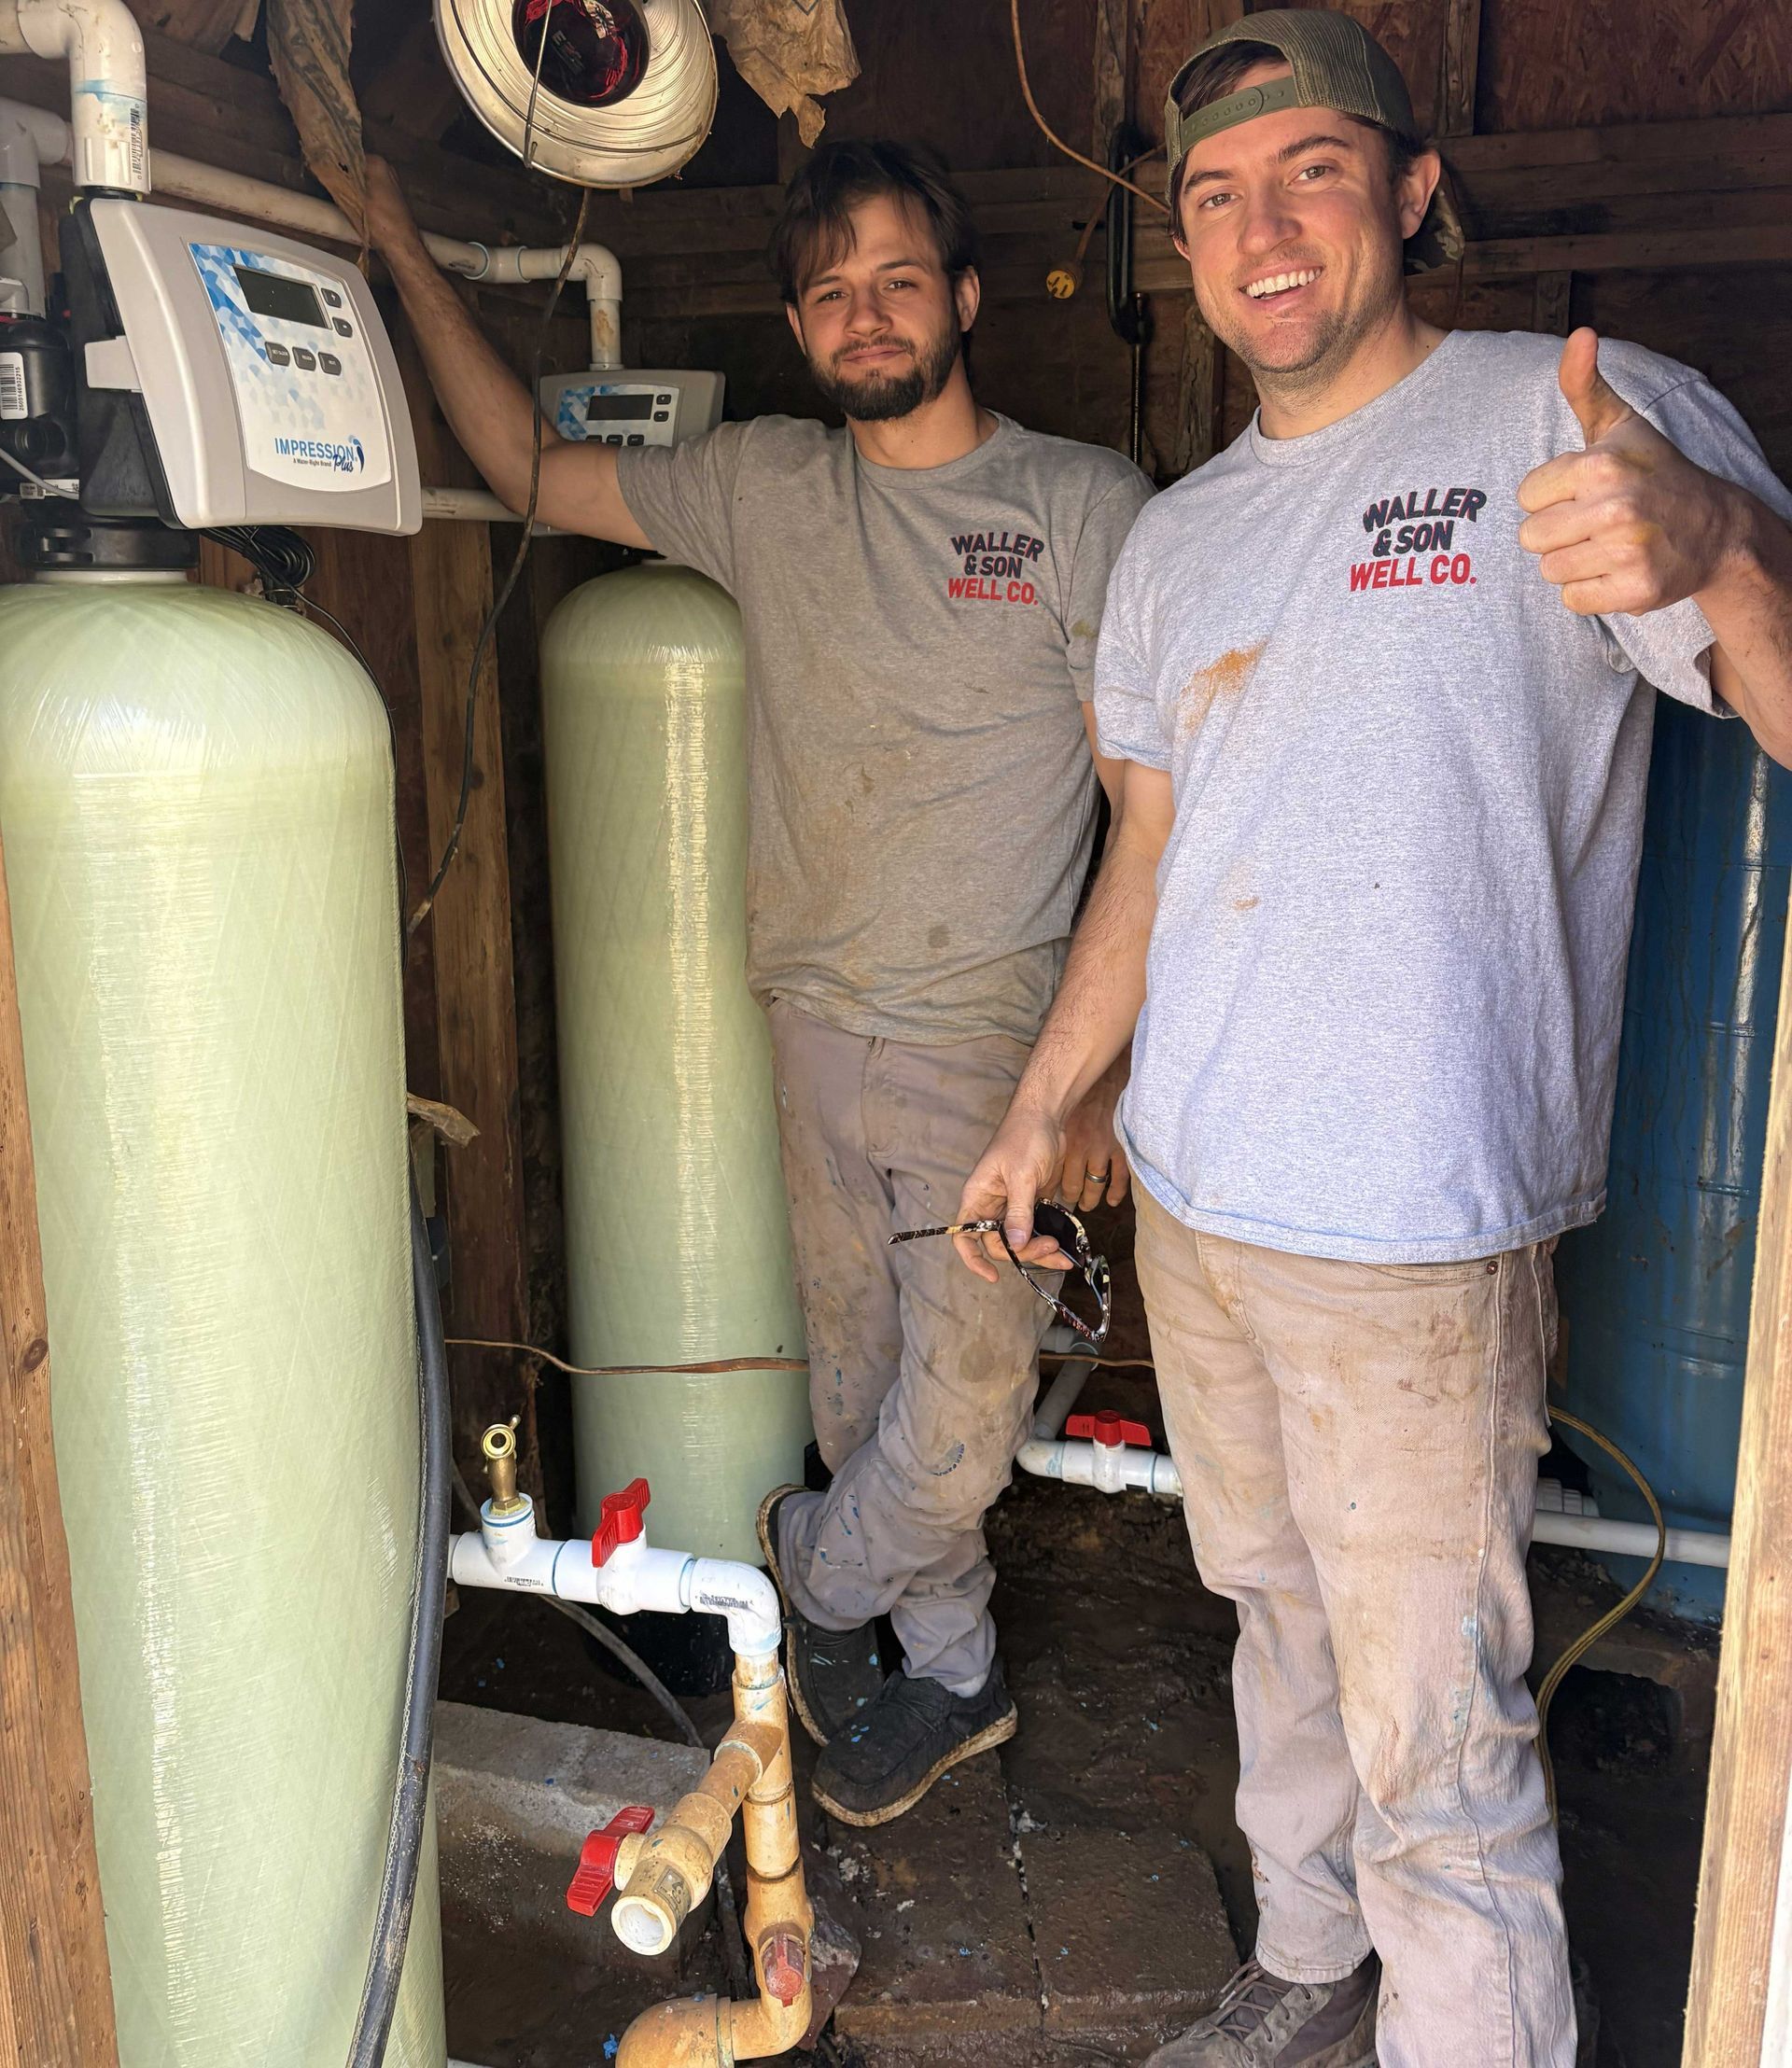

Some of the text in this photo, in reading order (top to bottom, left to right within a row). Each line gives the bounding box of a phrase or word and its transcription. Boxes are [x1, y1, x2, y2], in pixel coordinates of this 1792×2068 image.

[274, 437, 355, 462] IMPRESSION
[332, 454, 355, 473] Plus
[1362, 487, 1488, 534] WALLER
[950, 531, 1045, 564] WALLER
[1372, 519, 1455, 558] & SON
[964, 554, 1023, 580] & SON
[1350, 552, 1477, 593] WELL CO.
[948, 578, 1039, 607] WELL CO.
